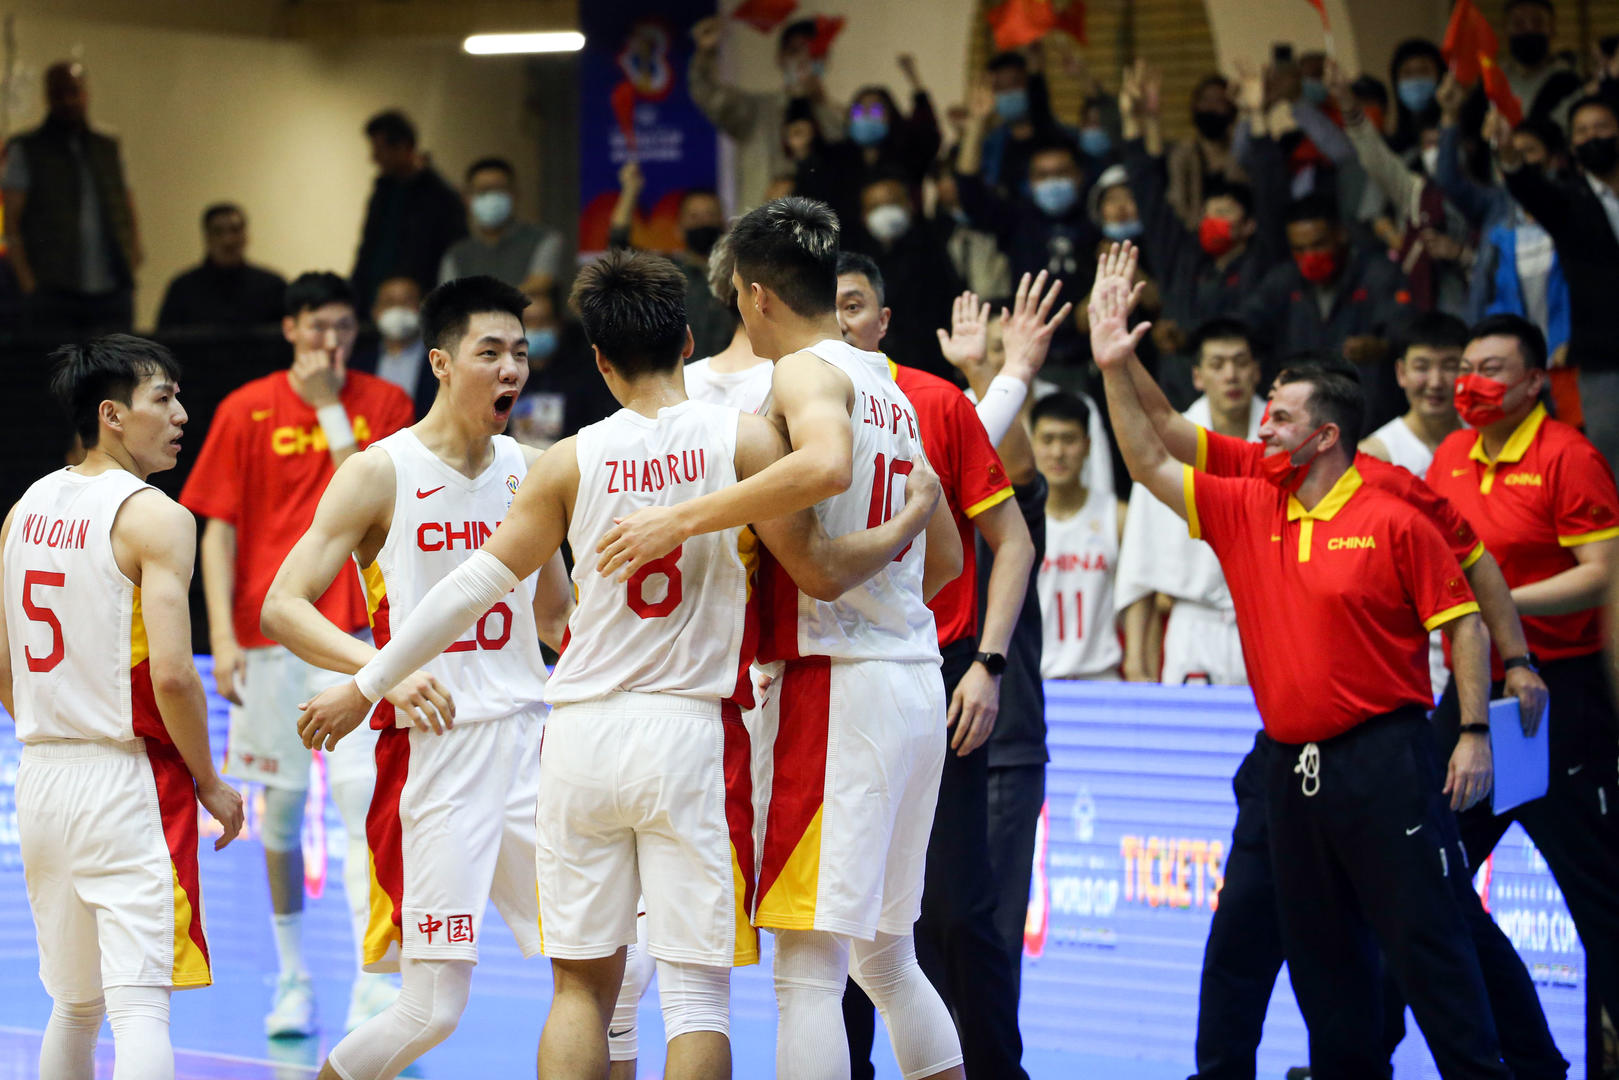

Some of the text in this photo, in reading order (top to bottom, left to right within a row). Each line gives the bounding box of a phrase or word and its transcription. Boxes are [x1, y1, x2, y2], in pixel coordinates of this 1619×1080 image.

[605, 448, 705, 494] ZHAO RUI
[22, 512, 91, 550] WU QIAN
[416, 520, 503, 553] CHIN
[1327, 535, 1377, 551] CHINA
[22, 569, 66, 673] 5
[1055, 590, 1083, 642] 11
[1121, 835, 1225, 912] TICKETS
[417, 913, 474, 945] 中国
